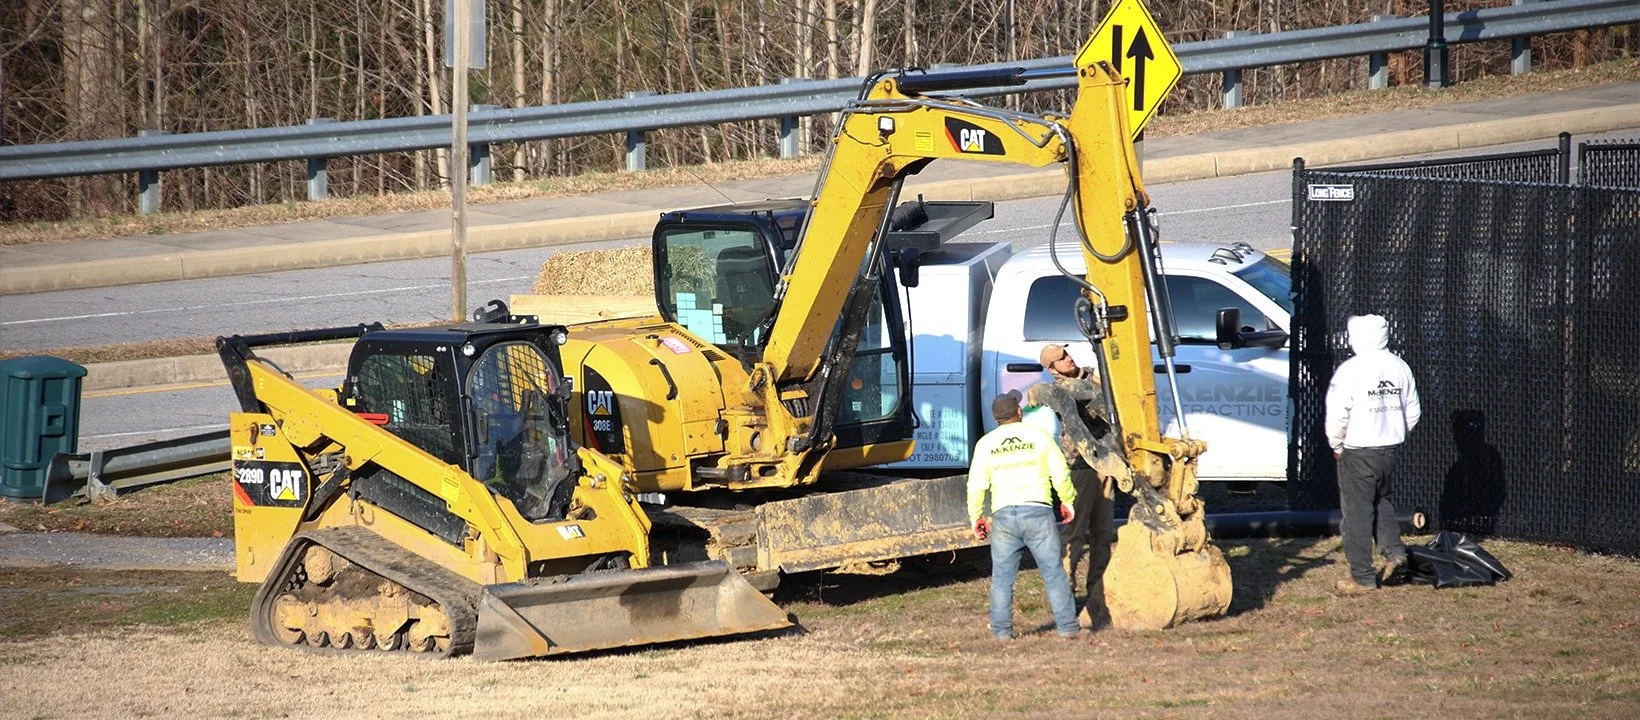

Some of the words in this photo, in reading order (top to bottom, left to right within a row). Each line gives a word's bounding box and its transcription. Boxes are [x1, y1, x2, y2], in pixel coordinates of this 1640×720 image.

[960, 128, 985, 152] CAT
[1312, 187, 1328, 197] LONG
[1330, 187, 1351, 197] FENCE
[1160, 383, 1282, 401] cKENZIE
[587, 390, 613, 415] CAT
[1156, 404, 1281, 416] NRACTING
[991, 443, 1036, 455] McKENZIE
[924, 453, 960, 462] 2980705
[240, 468, 264, 484] 289D
[270, 469, 302, 500] CAT
